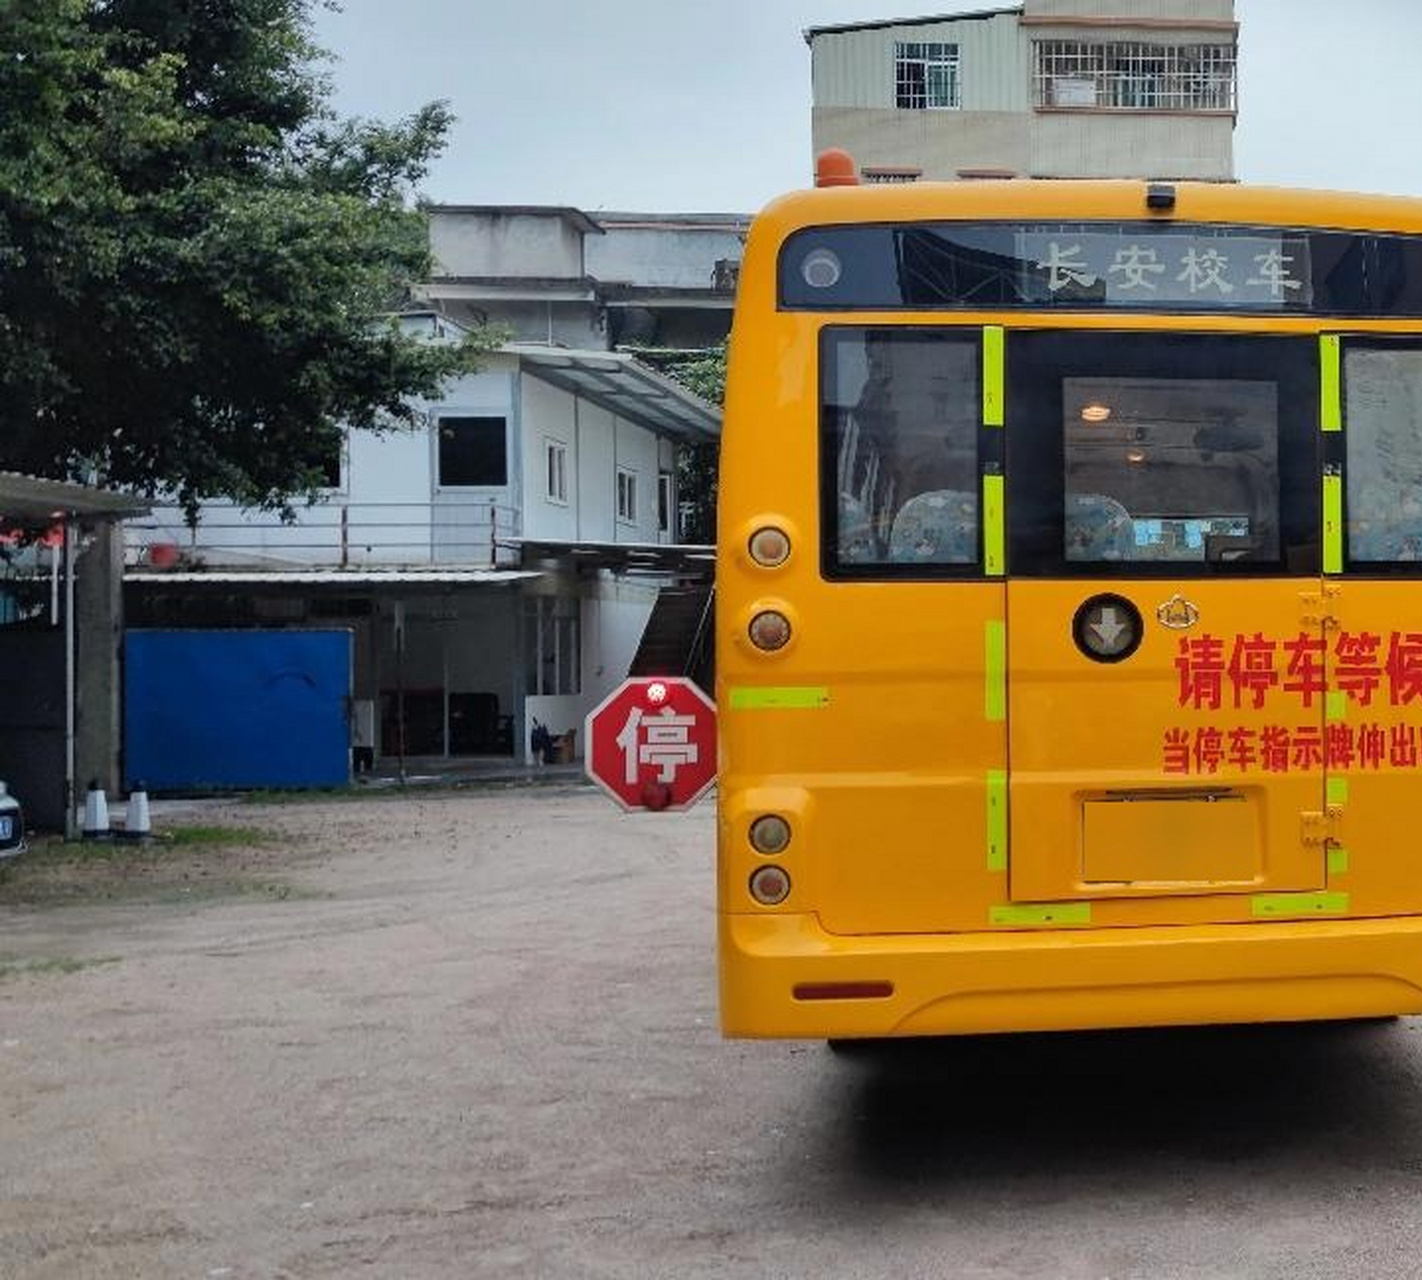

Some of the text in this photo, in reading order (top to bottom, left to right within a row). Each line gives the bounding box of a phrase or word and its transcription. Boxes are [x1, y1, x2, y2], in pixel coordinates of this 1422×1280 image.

[1036, 243, 1302, 294] 长安校车
[615, 705, 699, 785] 停
